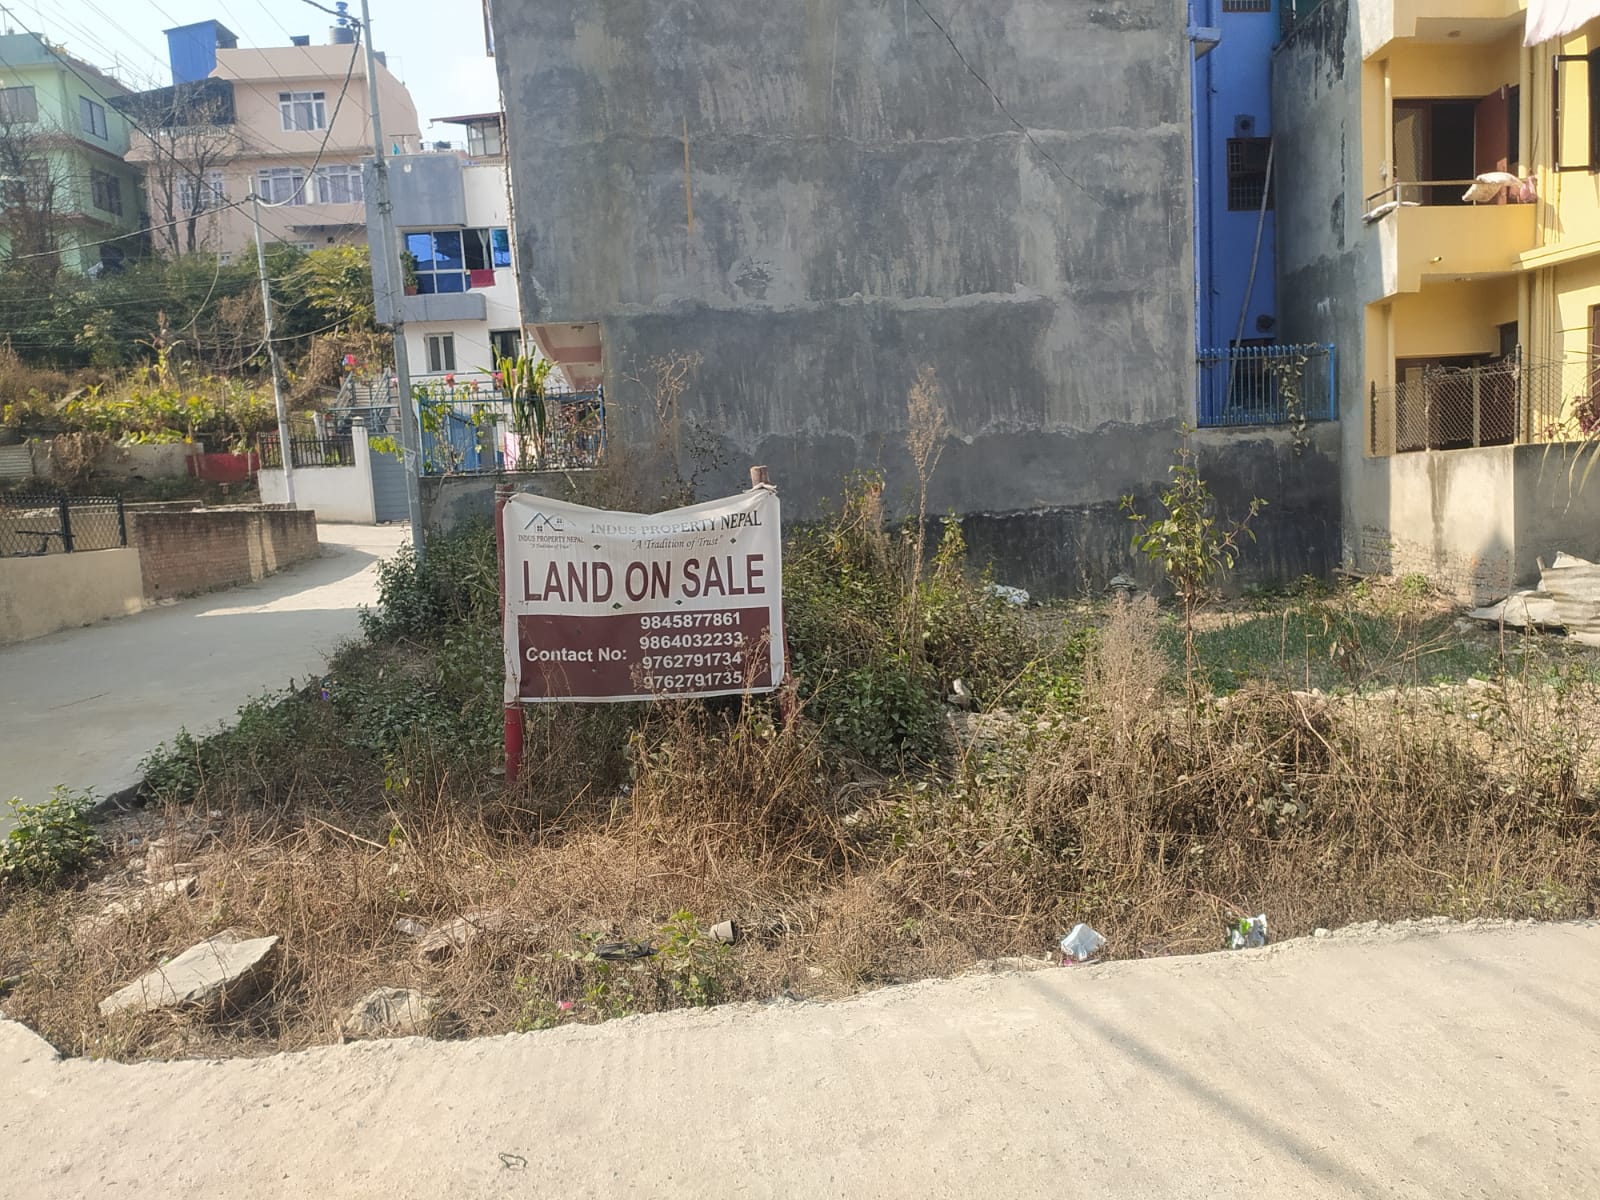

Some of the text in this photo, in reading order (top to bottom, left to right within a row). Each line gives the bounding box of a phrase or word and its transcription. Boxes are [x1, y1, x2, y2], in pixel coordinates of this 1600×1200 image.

[591, 510, 762, 536] INDUS PROPERTY NEPAL
[536, 535, 565, 543] PROPERTY
[566, 536, 585, 544] NEPAL
[646, 538, 684, 549] Tradition
[686, 537, 698, 550] of
[524, 554, 765, 602] LAND ON SALE
[640, 611, 741, 630] 9845877861
[639, 631, 744, 650] 9864032233
[525, 647, 628, 662] Contact No:
[642, 651, 743, 670] 9762791734
[643, 671, 743, 690] 9762791735
